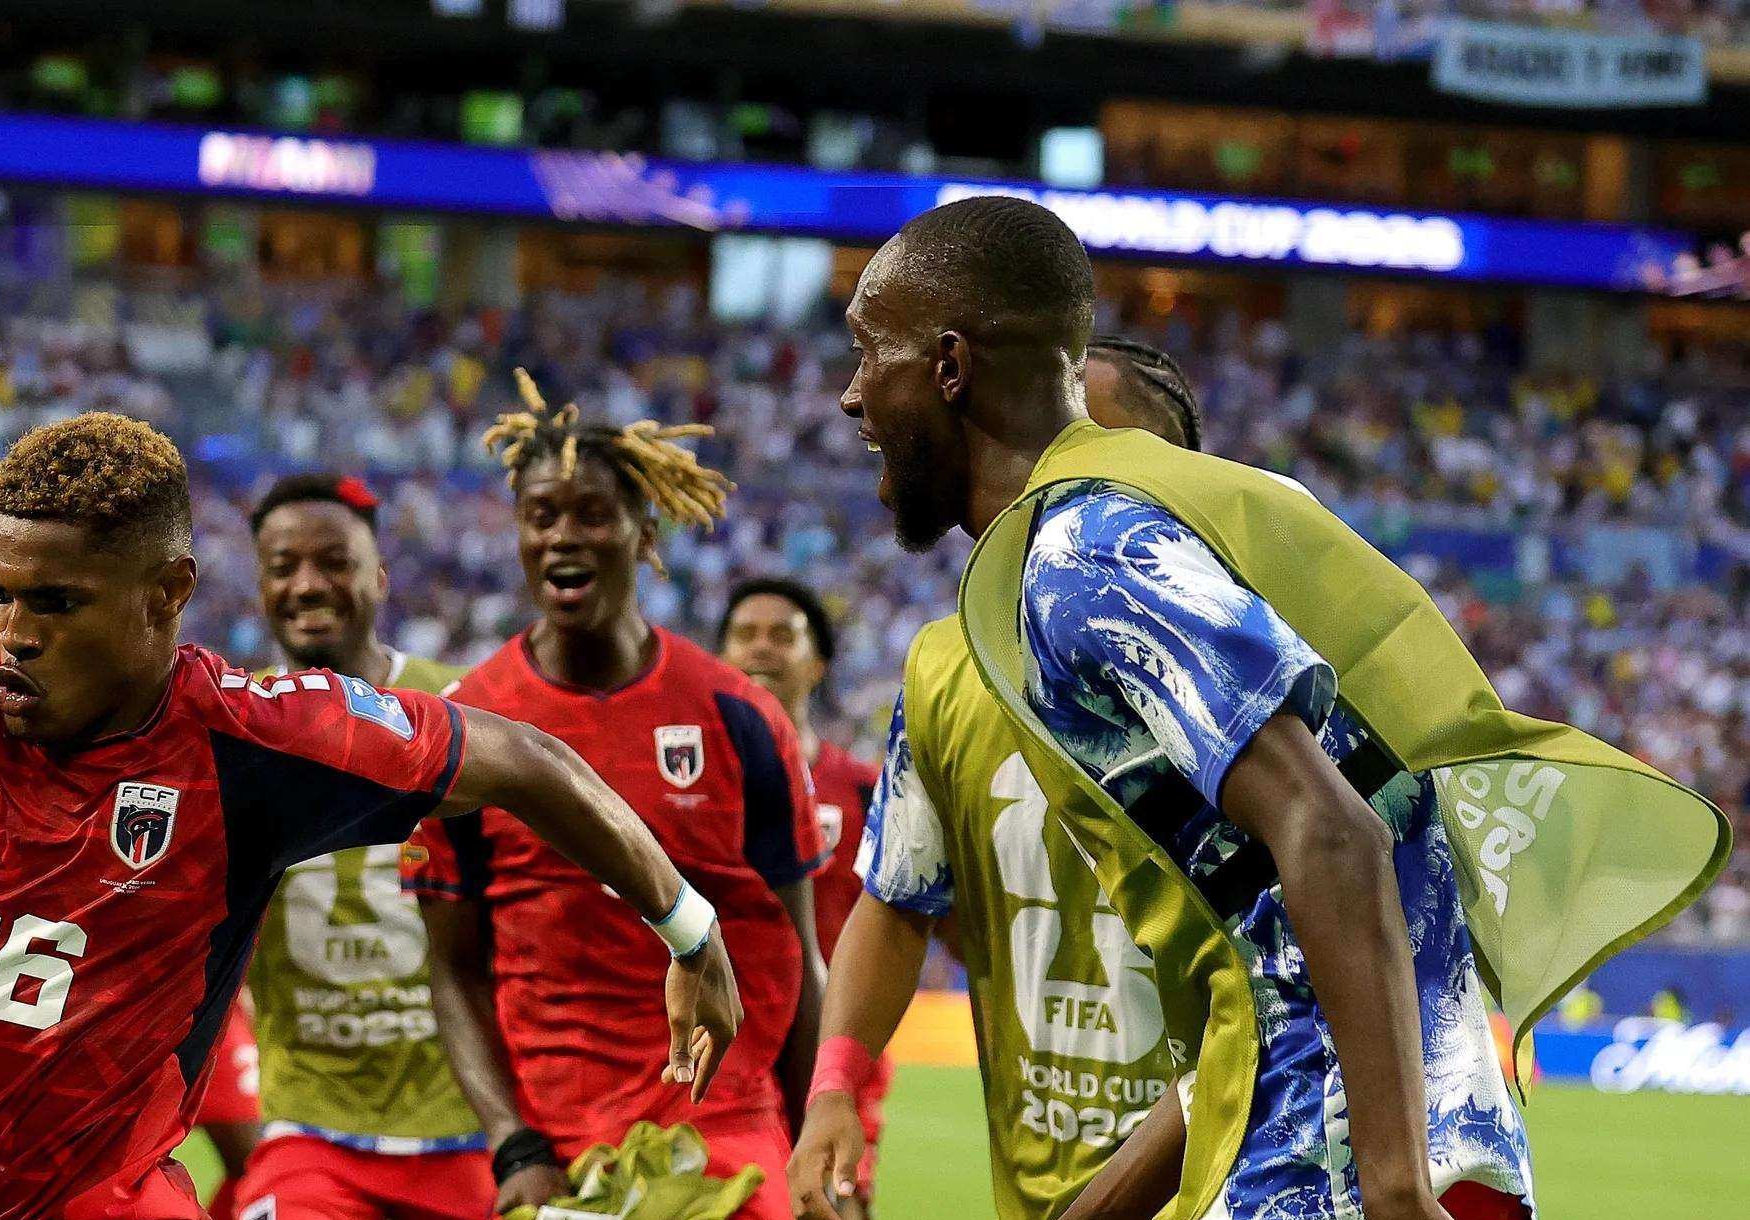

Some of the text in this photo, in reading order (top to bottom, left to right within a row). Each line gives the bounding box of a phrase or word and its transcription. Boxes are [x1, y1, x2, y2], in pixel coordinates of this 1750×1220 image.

[122, 785, 175, 802] FCF
[1044, 995, 1118, 1034] FIFA
[1018, 1055, 1099, 1099] WORLD
[1105, 1075, 1169, 1105] CUP
